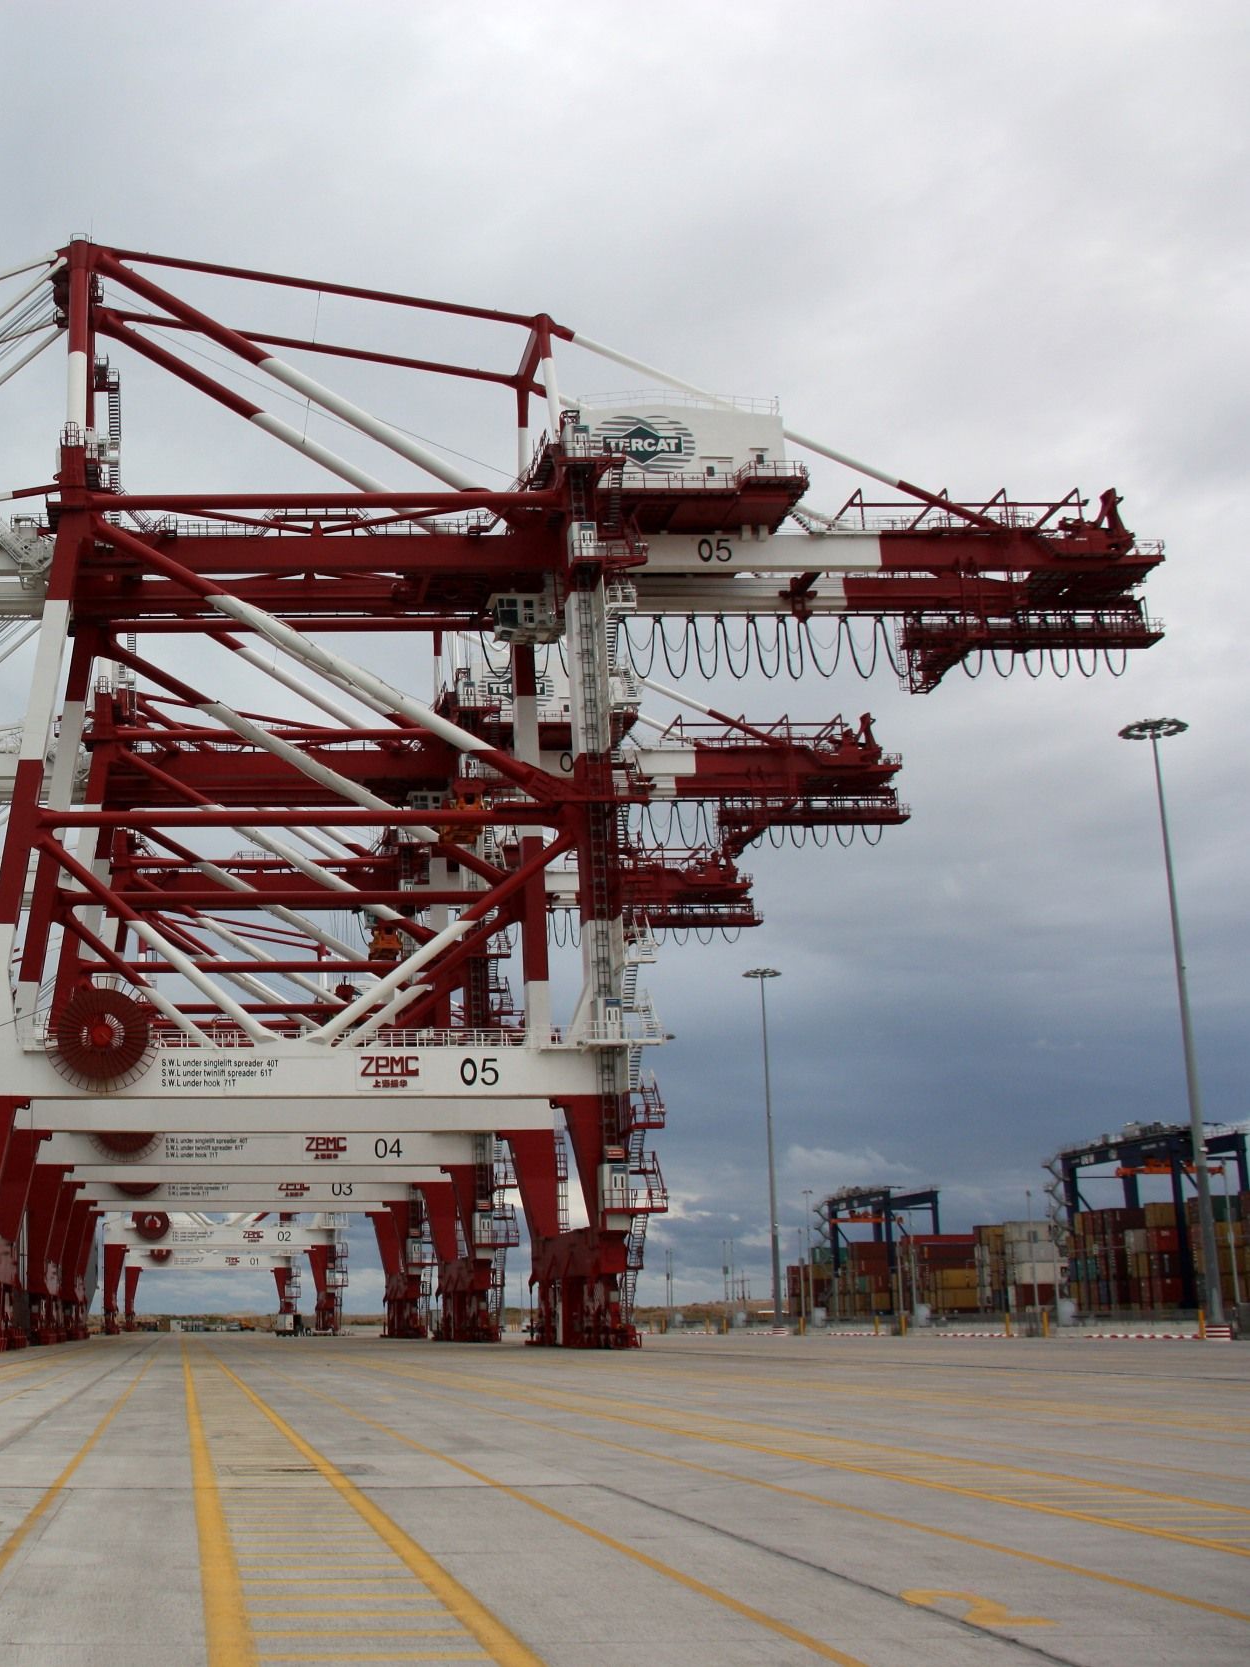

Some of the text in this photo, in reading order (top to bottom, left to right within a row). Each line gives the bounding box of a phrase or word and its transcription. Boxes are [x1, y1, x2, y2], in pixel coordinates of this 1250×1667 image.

[606, 438, 678, 452] TERCAT
[698, 538, 732, 562] 05
[161, 1059, 279, 1069] S.W.L under singlelift spreader 40T
[360, 1056, 419, 1077] ZPMC
[161, 1069, 272, 1079] S.W.L under twinlift spreader 61T
[460, 1058, 499, 1086] 05
[161, 1079, 236, 1087] S.W.L under hook 71T
[305, 1137, 347, 1152] ZPMC
[374, 1138, 403, 1158] 04
[332, 1183, 353, 1196] 03
[242, 1230, 264, 1239] ZPMC
[277, 1231, 291, 1242] 02
